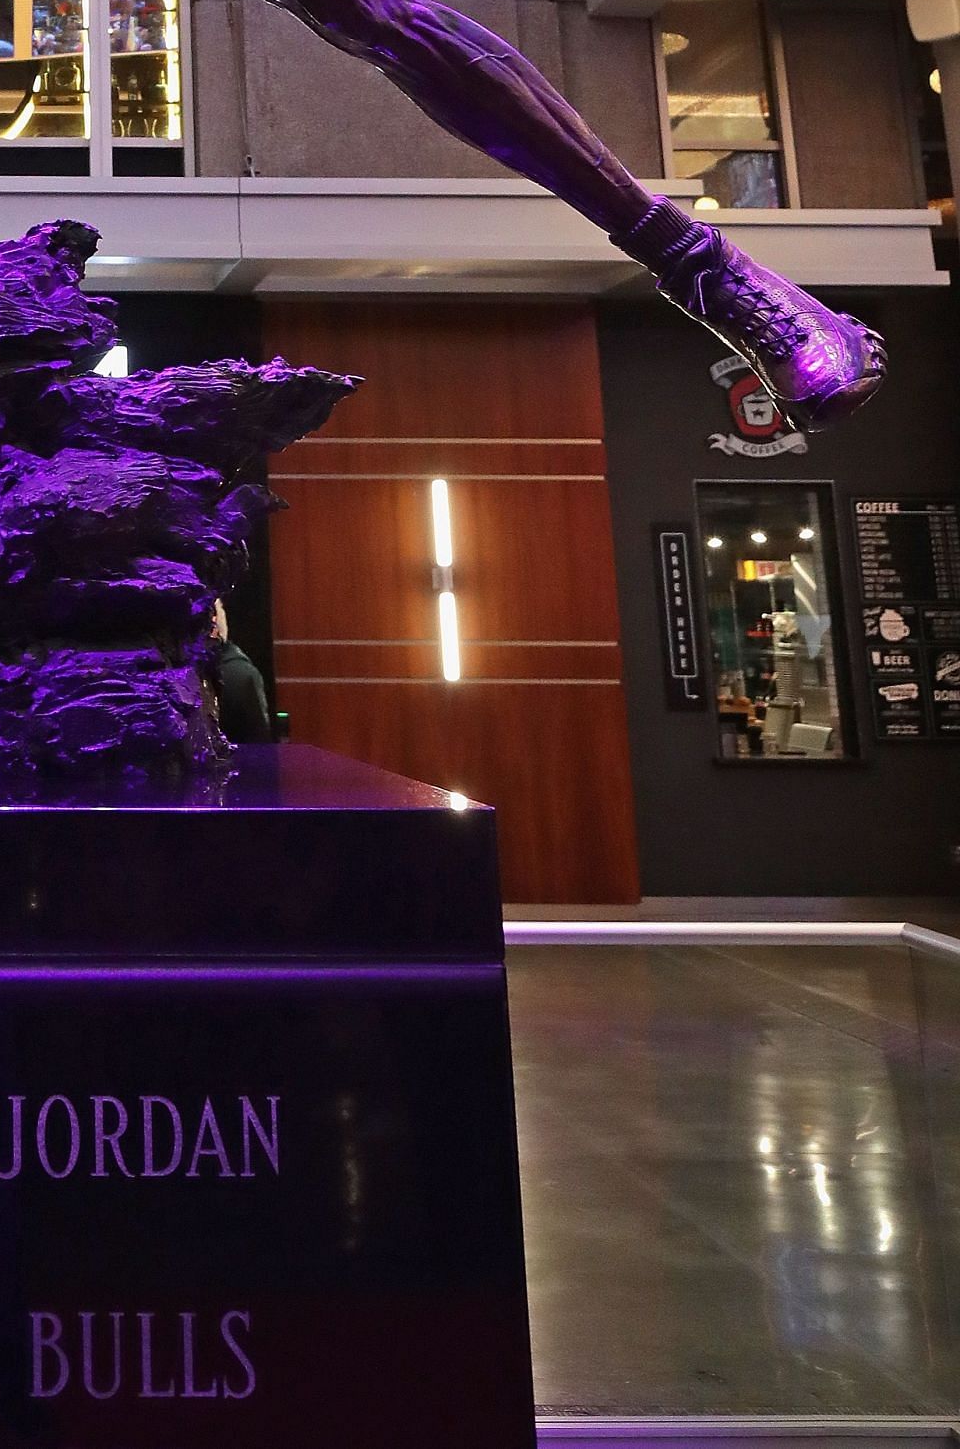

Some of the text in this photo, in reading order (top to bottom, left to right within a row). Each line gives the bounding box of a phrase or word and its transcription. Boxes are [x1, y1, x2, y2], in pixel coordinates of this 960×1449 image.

[742, 443, 785, 455] COFFEE
[855, 502, 901, 513] COFFEE
[669, 541, 689, 669] ORDER HERE
[883, 655, 912, 666] BEER
[29, 1310, 257, 1400] BULLS
